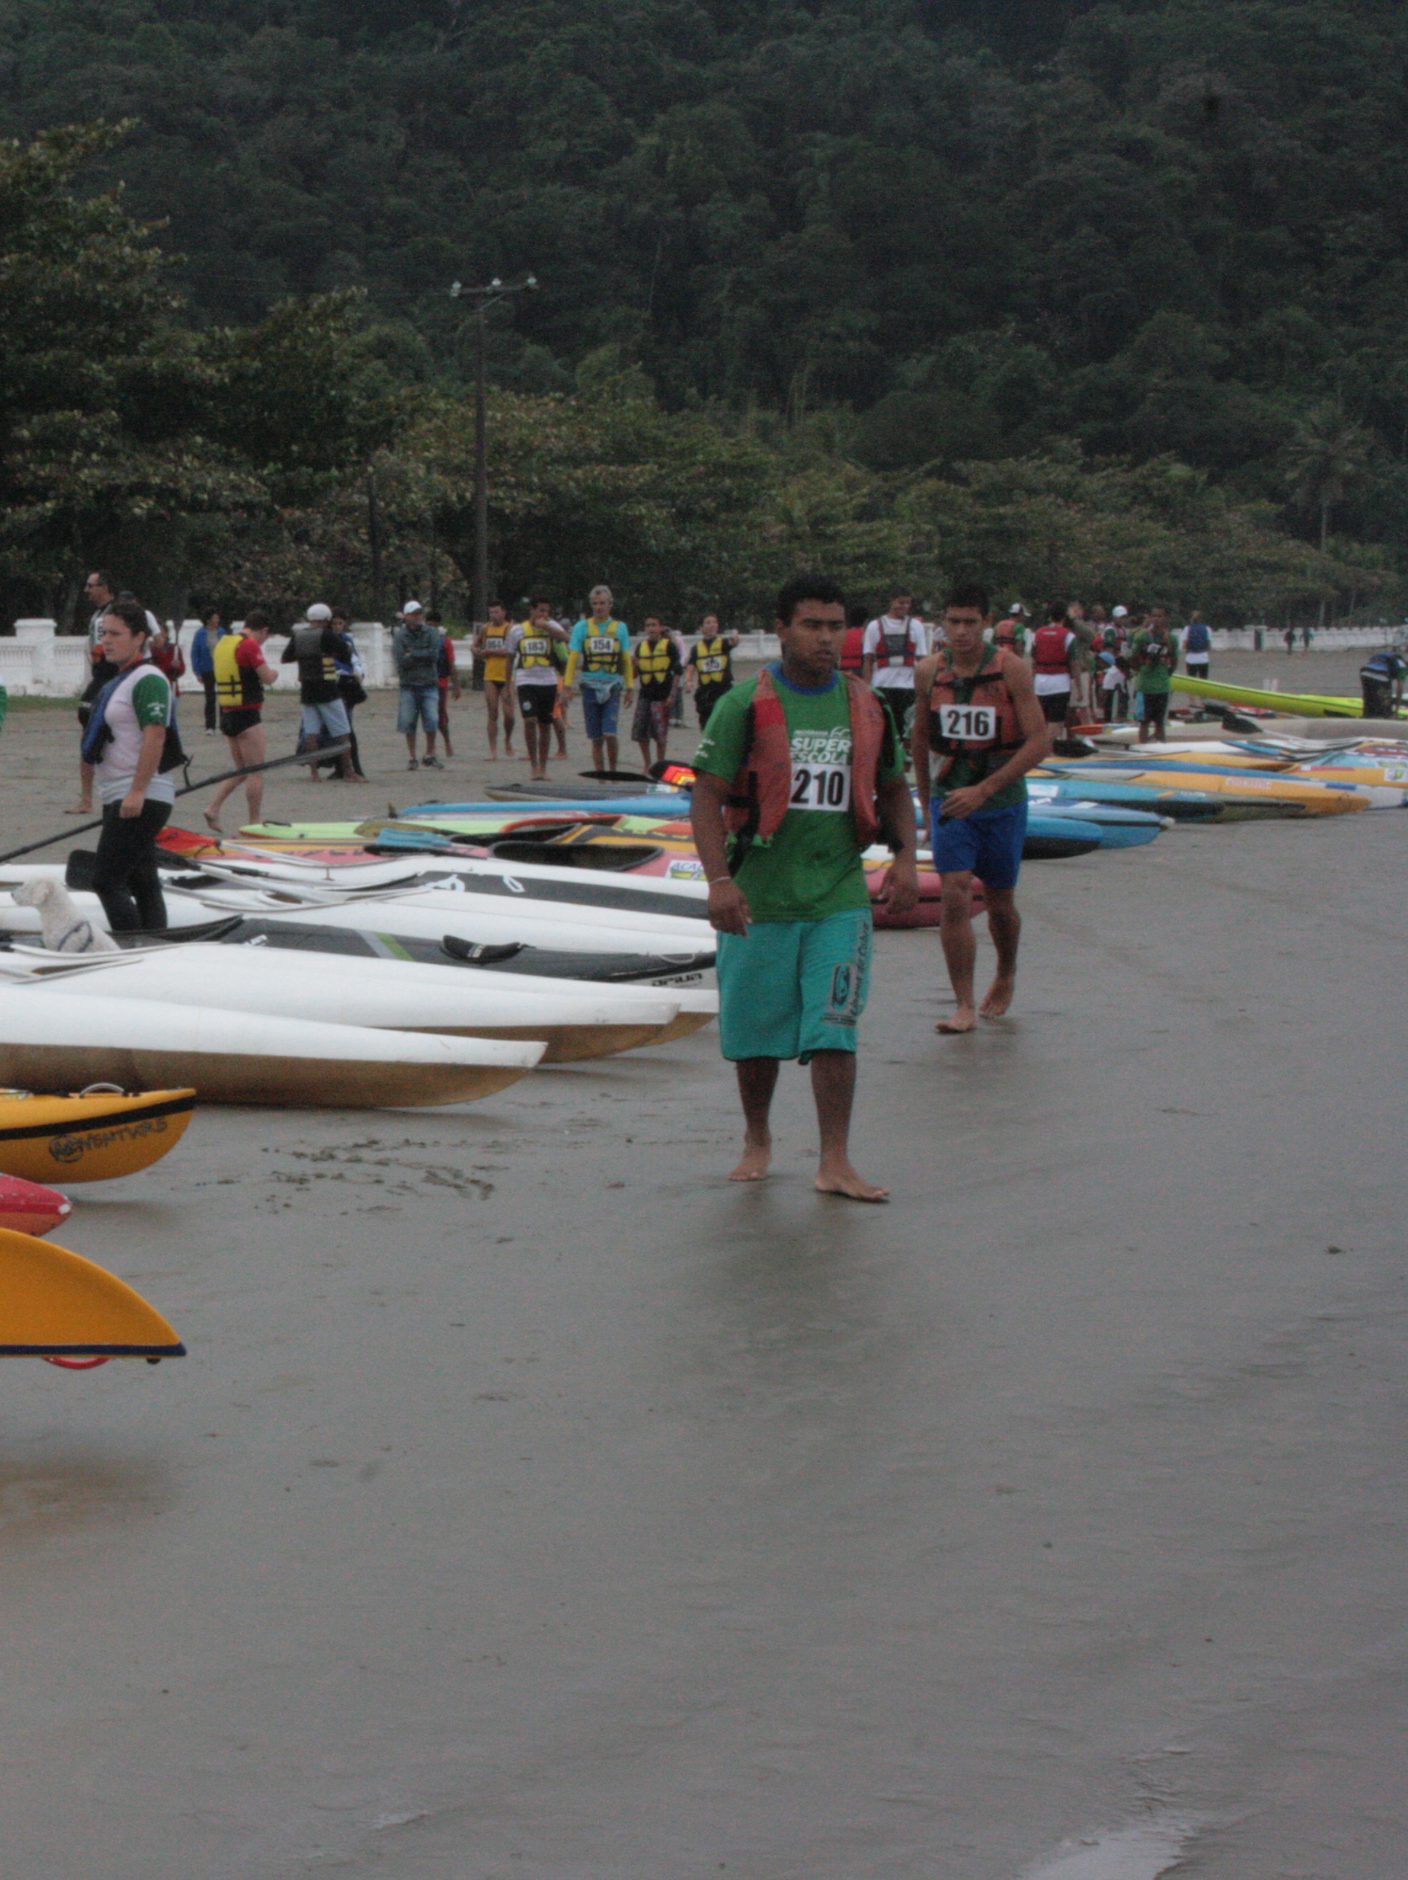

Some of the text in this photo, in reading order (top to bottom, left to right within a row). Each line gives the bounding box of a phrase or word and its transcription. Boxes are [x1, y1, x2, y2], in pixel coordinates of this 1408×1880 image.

[947, 710, 989, 737] 216
[792, 737, 852, 752] SUPER
[791, 768, 845, 806] 210
